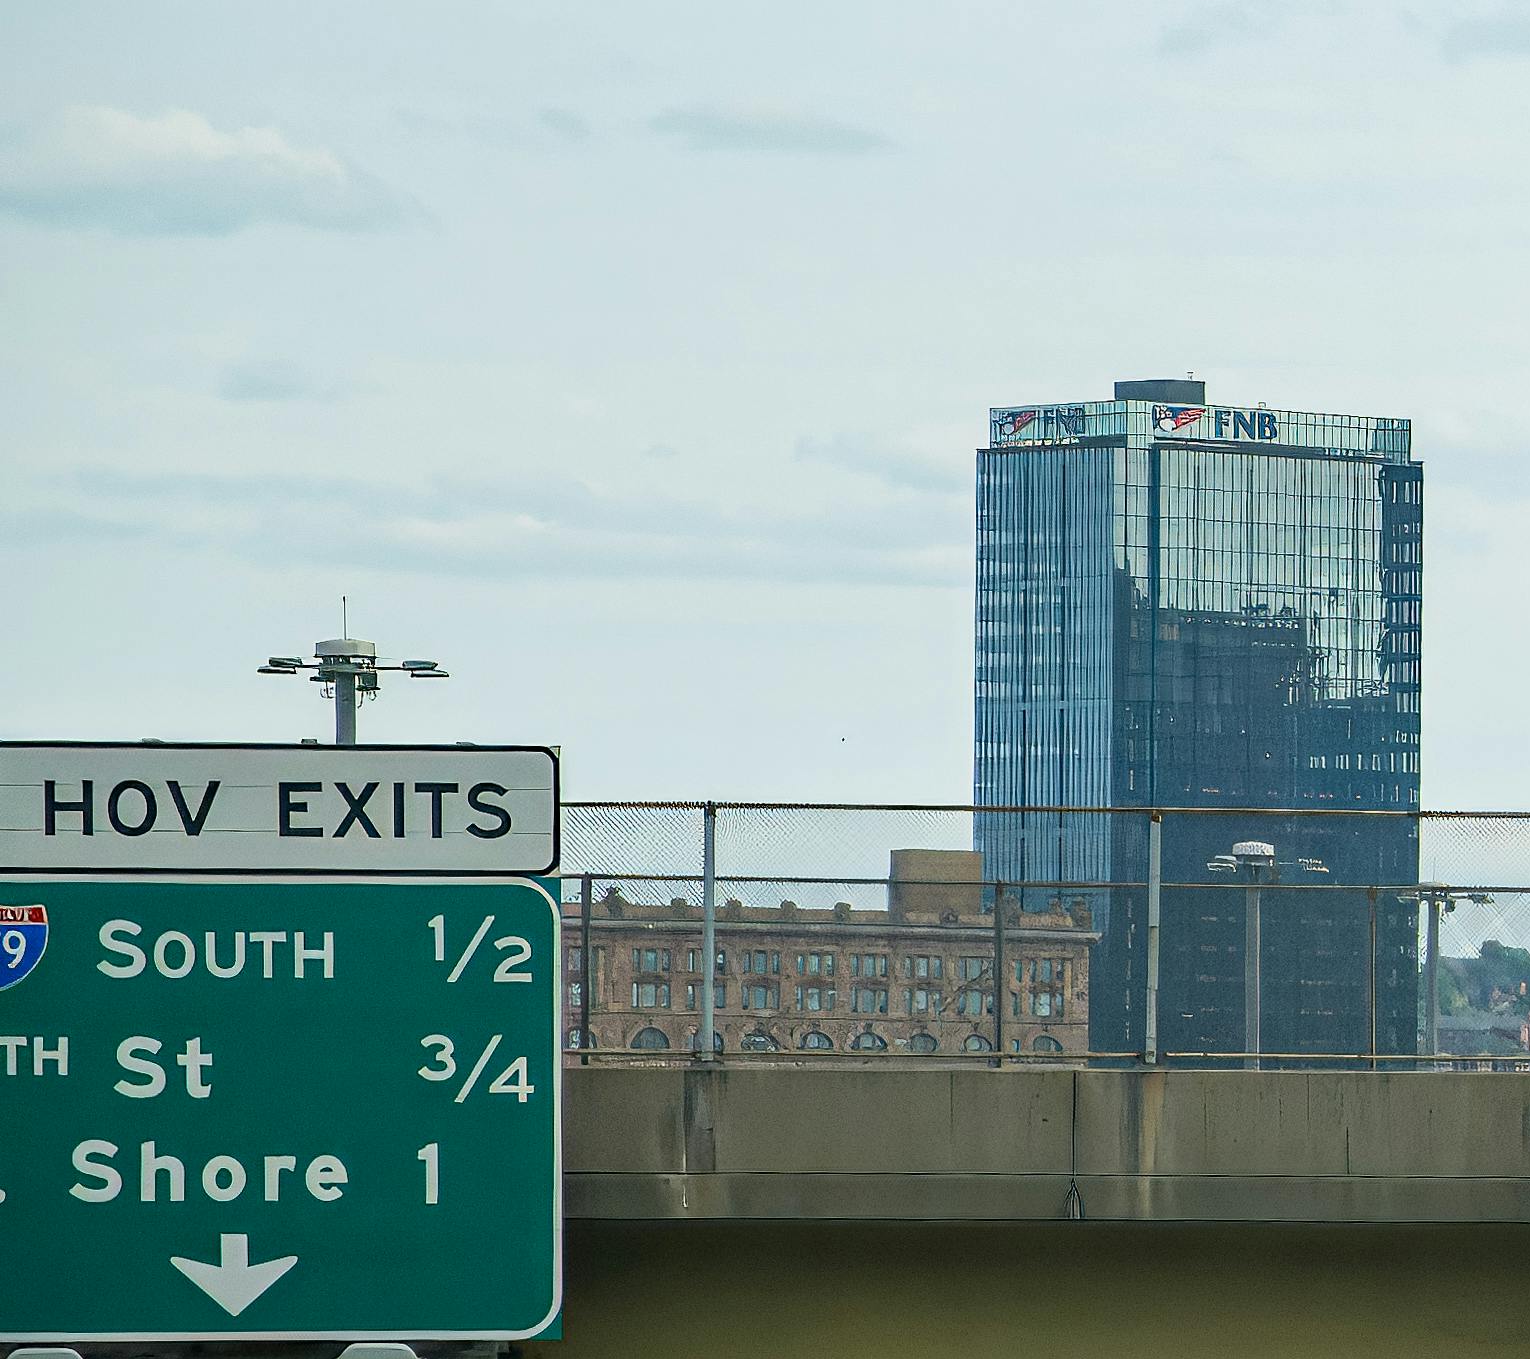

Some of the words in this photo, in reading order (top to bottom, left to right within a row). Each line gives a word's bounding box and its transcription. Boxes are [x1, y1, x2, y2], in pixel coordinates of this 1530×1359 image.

[1214, 410, 1278, 440] FNB
[44, 779, 221, 837] HOV
[279, 781, 513, 839] EXITS
[0, 927, 26, 970] 9
[97, 918, 335, 980] SOUTH
[428, 915, 534, 984] 1/2
[113, 1035, 213, 1099] St
[418, 1034, 535, 1103] 3/4
[69, 1140, 349, 1203] Shore
[416, 1142, 439, 1205] 1
